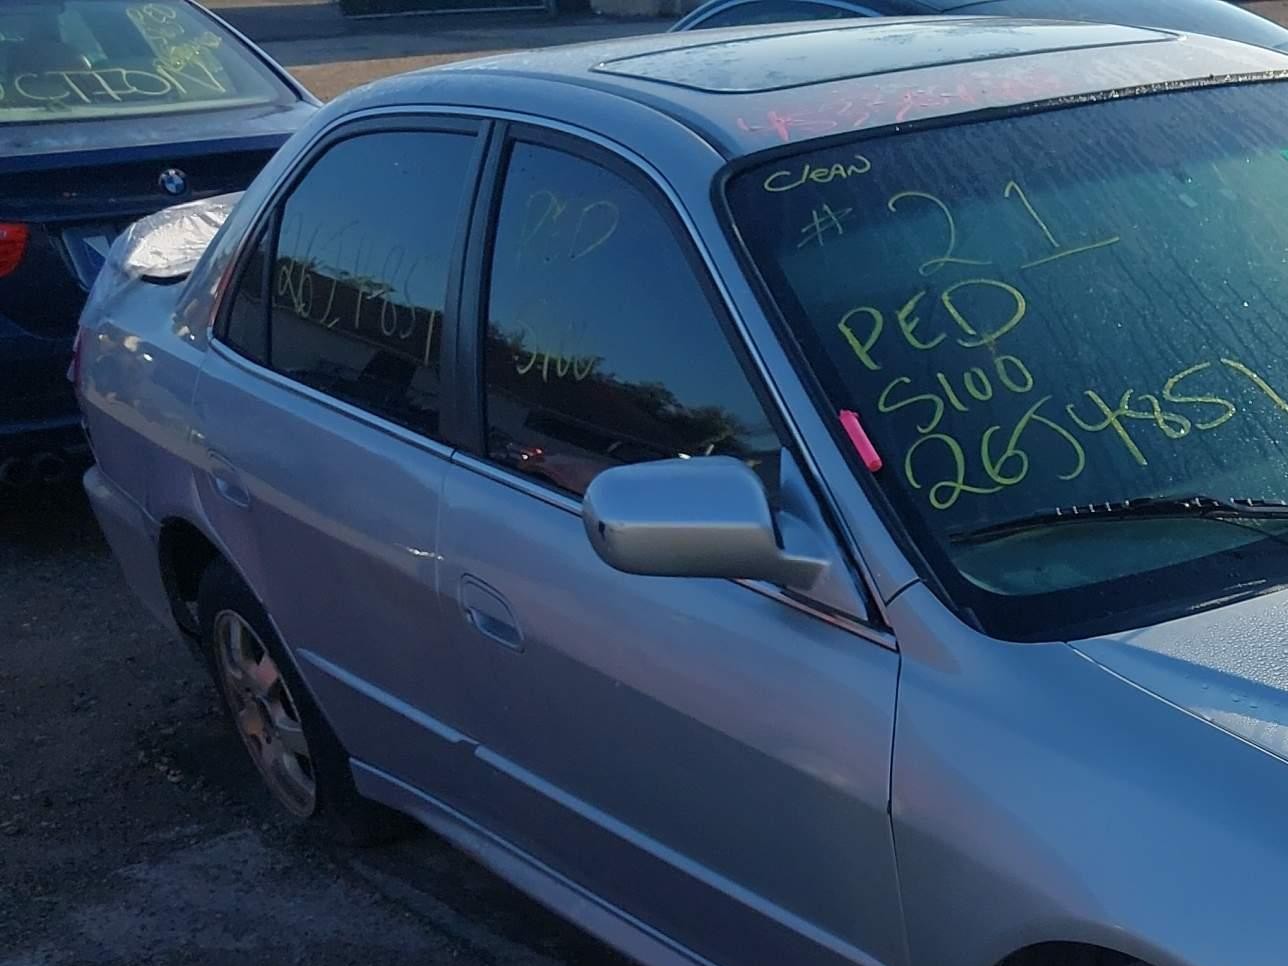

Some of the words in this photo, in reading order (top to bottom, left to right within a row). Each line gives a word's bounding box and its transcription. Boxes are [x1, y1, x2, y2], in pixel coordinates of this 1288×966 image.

[0, 67, 227, 104] CTION
[797, 203, 853, 248] #
[887, 181, 1119, 276] 21
[838, 279, 1026, 370] PED
[878, 355, 1034, 434] S100
